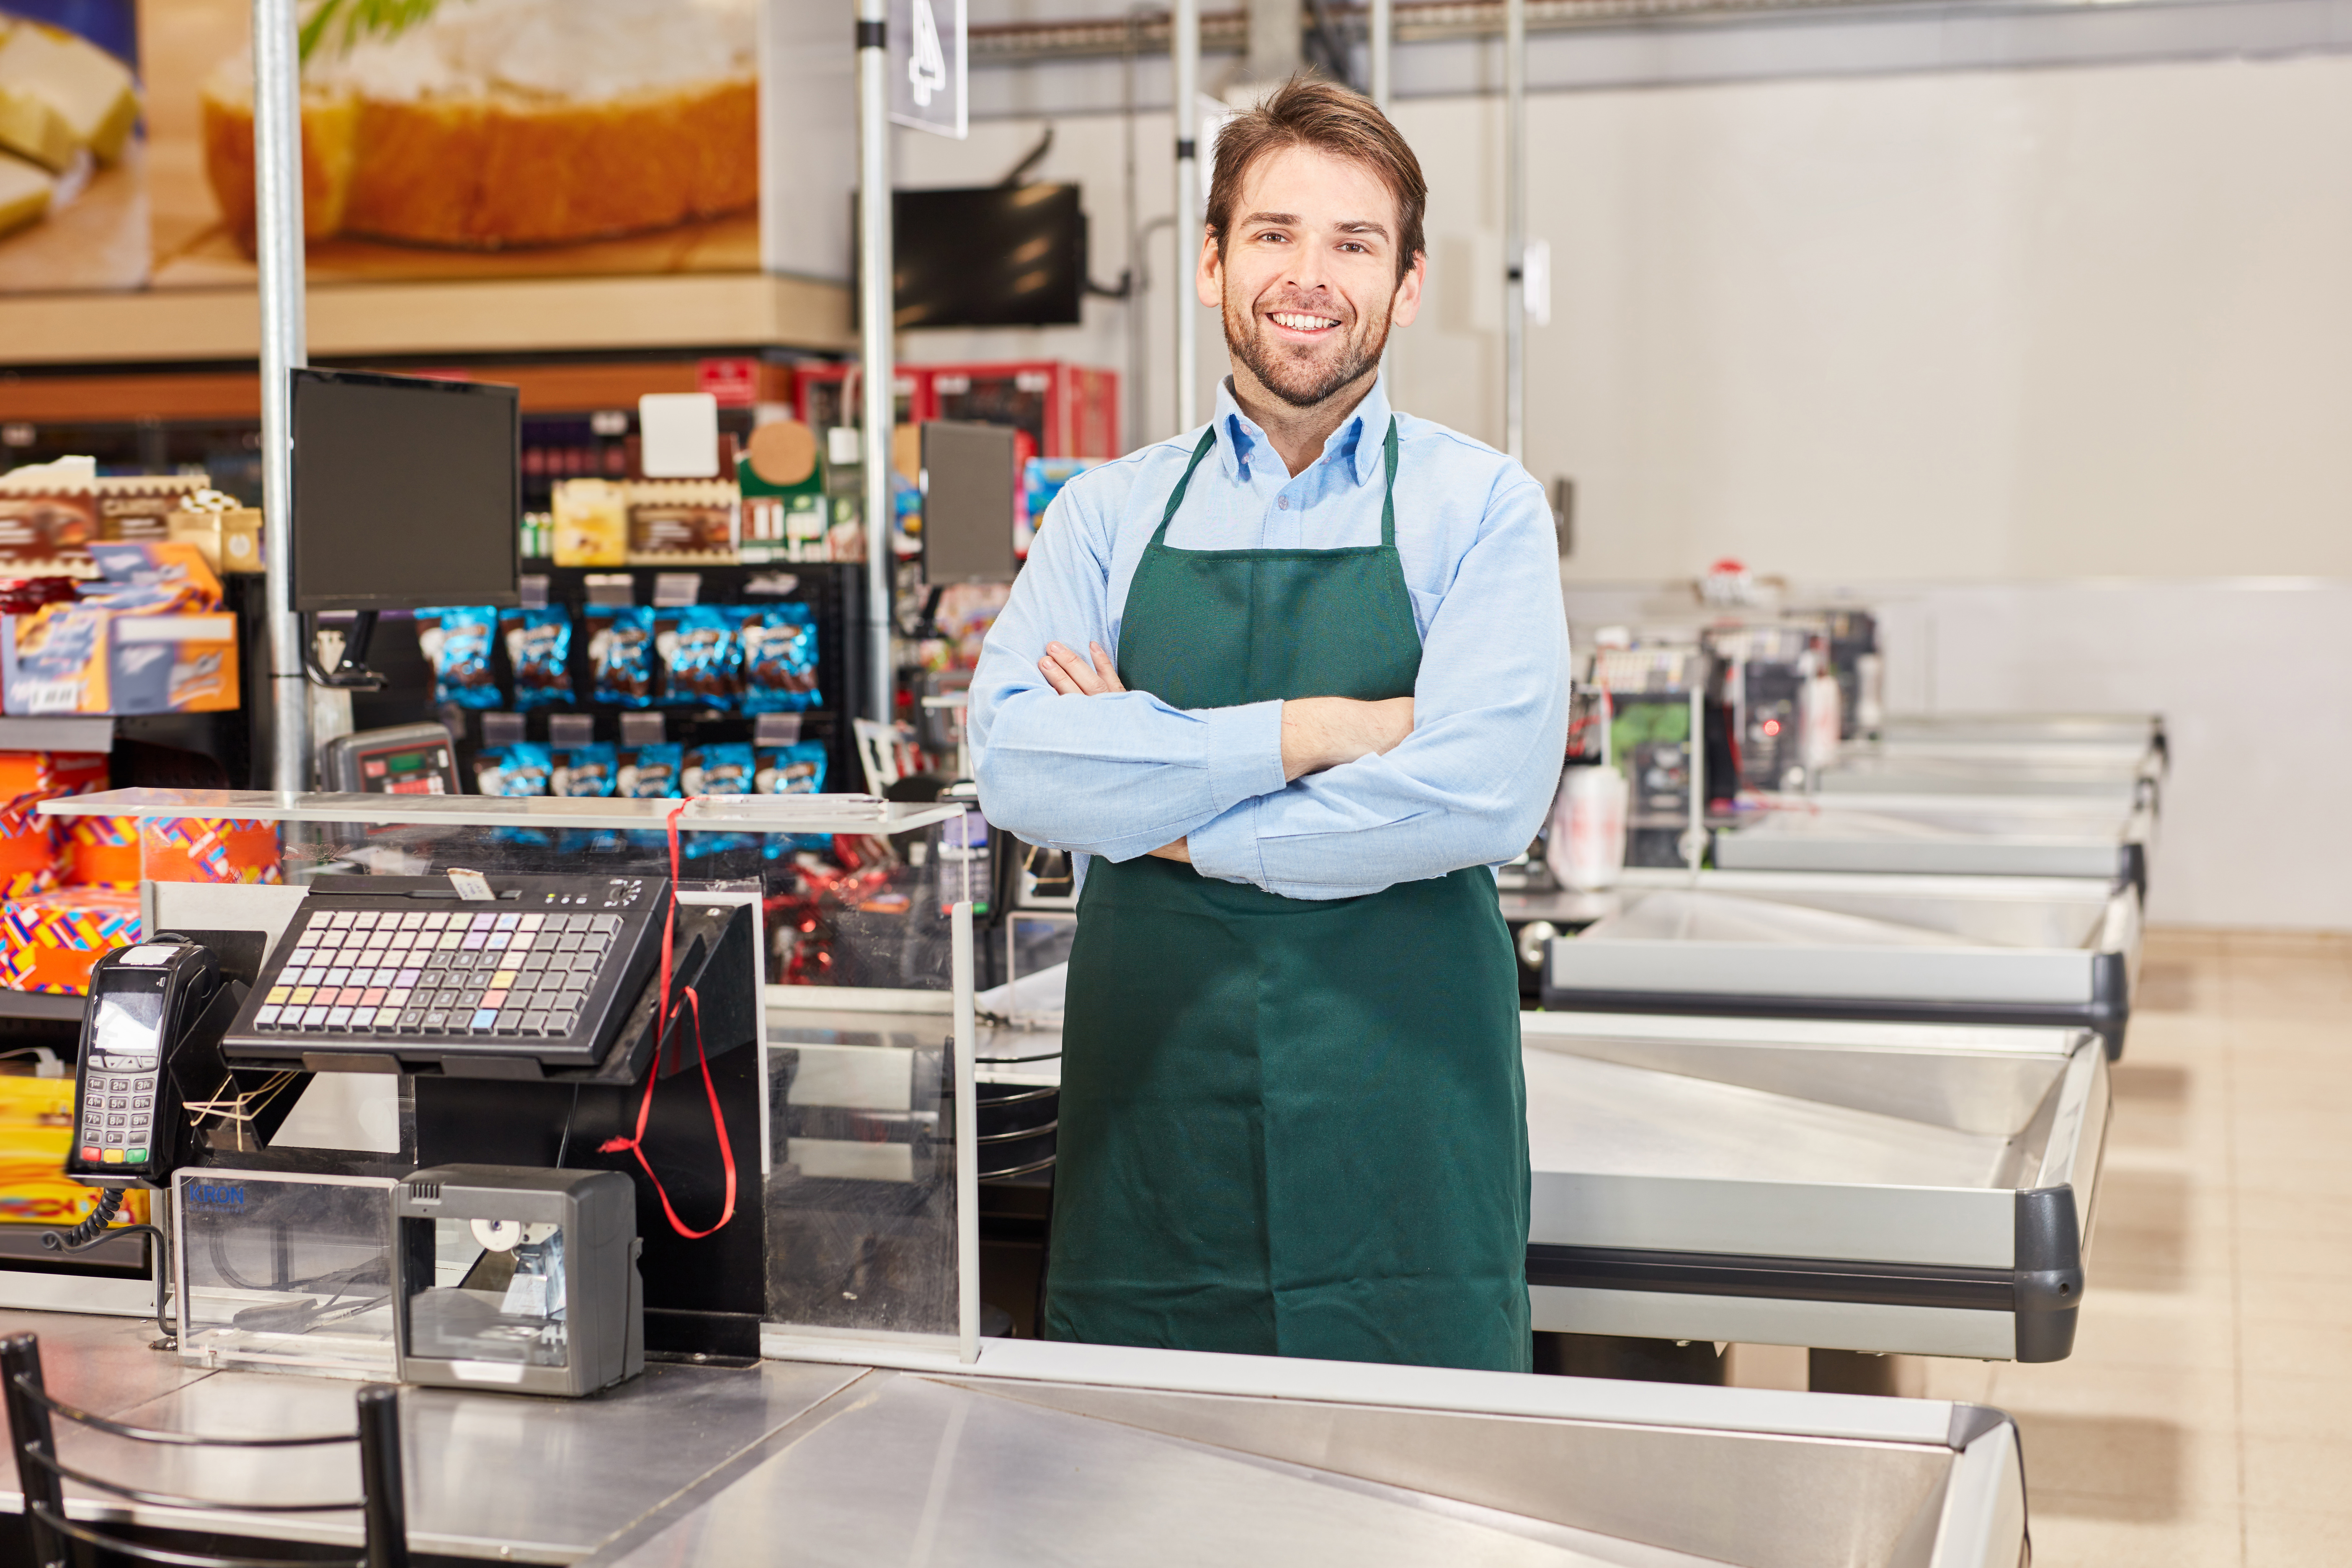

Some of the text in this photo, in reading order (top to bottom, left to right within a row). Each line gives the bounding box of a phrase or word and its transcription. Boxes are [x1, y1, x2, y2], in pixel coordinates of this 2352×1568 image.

[436, 955, 446, 963] 7
[460, 955, 469, 964] 8
[484, 955, 493, 965] 9
[426, 974, 435, 983] 4
[451, 974, 460, 983] 5
[475, 975, 484, 984] 6
[418, 993, 425, 1002] 1
[440, 993, 450, 1003] 2
[465, 994, 475, 1003] 3
[407, 1013, 416, 1022] 0
[428, 1013, 443, 1023] 00
[189, 1184, 244, 1204] KRON
